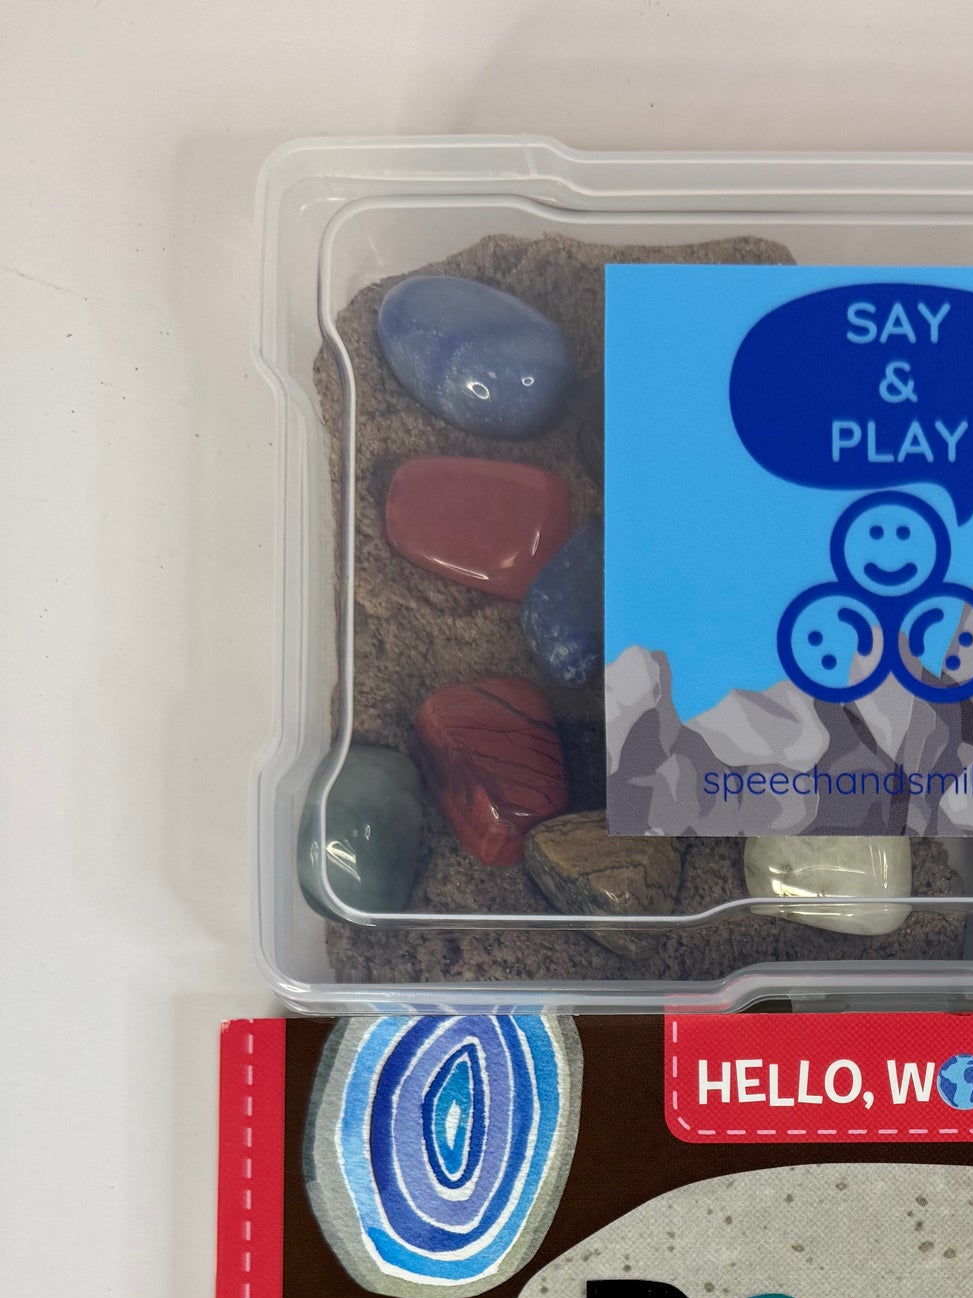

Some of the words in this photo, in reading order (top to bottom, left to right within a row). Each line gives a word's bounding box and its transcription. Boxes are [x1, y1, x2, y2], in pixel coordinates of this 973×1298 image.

[845, 302, 951, 344] SAY
[878, 361, 919, 403] &
[831, 420, 969, 463] PLAY
[698, 1058, 875, 1110] HELLO,
